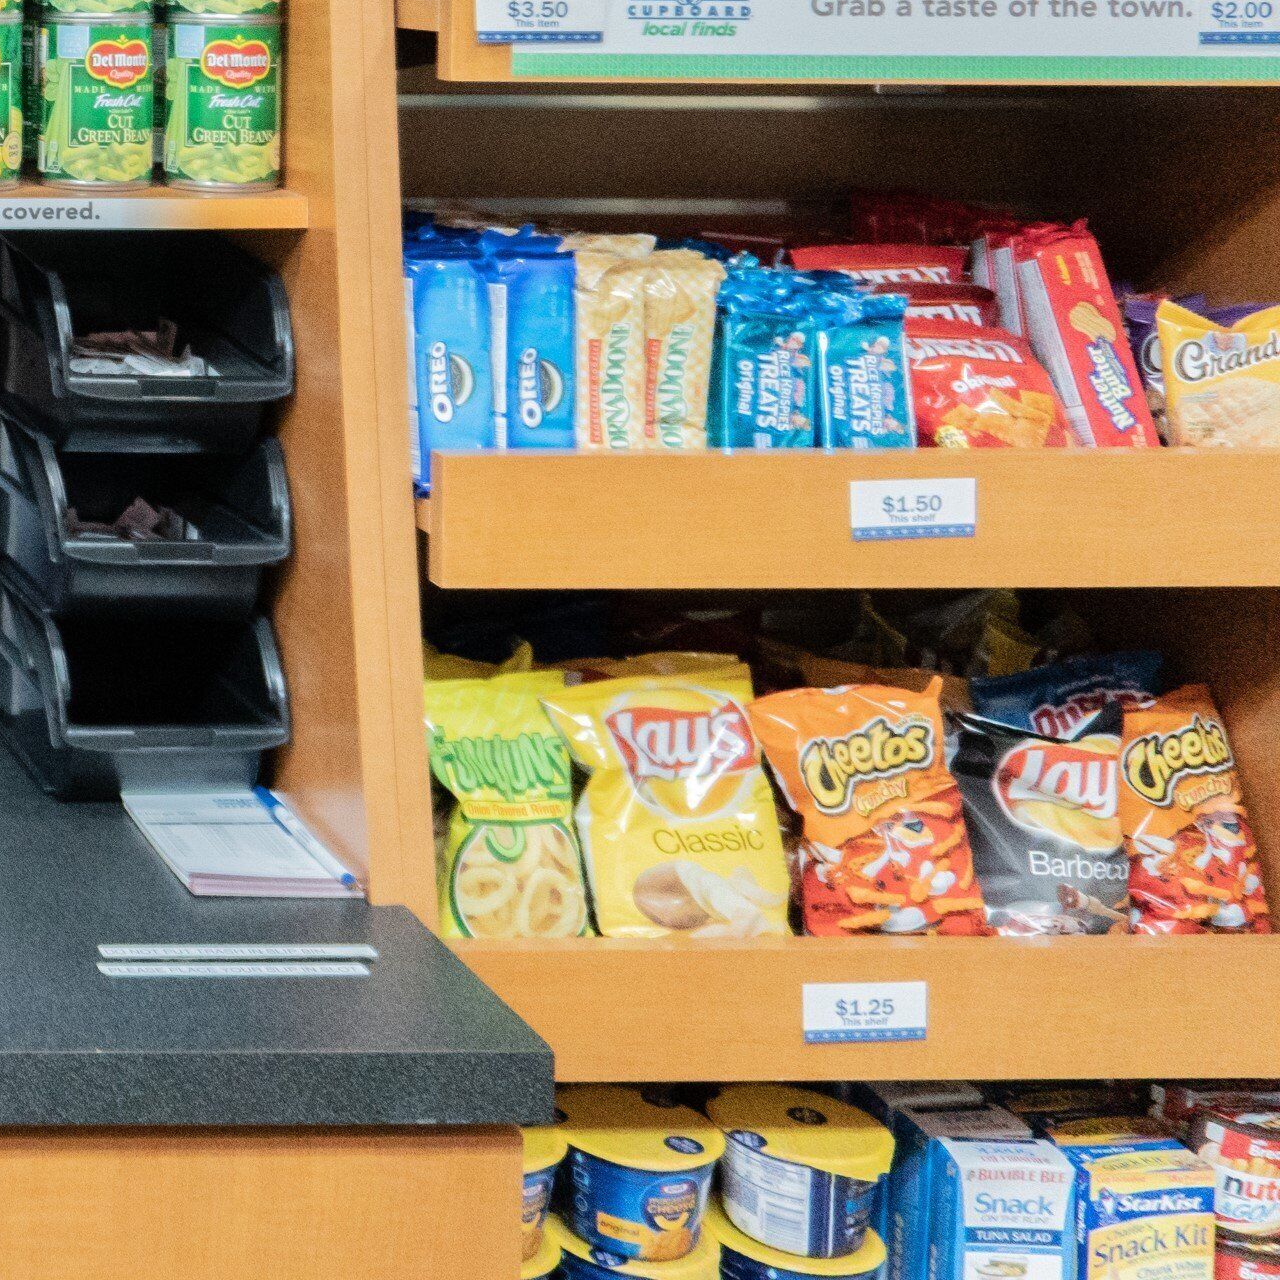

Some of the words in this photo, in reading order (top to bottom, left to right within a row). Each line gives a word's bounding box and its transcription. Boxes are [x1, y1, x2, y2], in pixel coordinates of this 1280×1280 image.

[507, 0, 568, 20] $3.50
[895, 0, 914, 18] a
[1210, 1, 1274, 21] $2.00
[643, 21, 685, 37] local
[688, 21, 737, 37] finds
[2, 201, 101, 221] covered.
[429, 341, 454, 423] OREO
[519, 347, 543, 428] OREO
[757, 354, 777, 428] TREATS
[882, 495, 943, 513] $1.50
[615, 700, 747, 781] Lay's
[802, 716, 934, 815] Cheetos
[1123, 716, 1232, 807] Cheetos
[652, 824, 765, 856] Classic
[835, 997, 895, 1017] $1.25
[974, 1192, 1056, 1216] Snack
[1118, 1194, 1203, 1213] StarKist
[976, 1232, 1009, 1244] TUNA
[1012, 1232, 1052, 1243] SALAD
[1093, 1232, 1167, 1269] Snack
[1174, 1225, 1208, 1248] Kit
